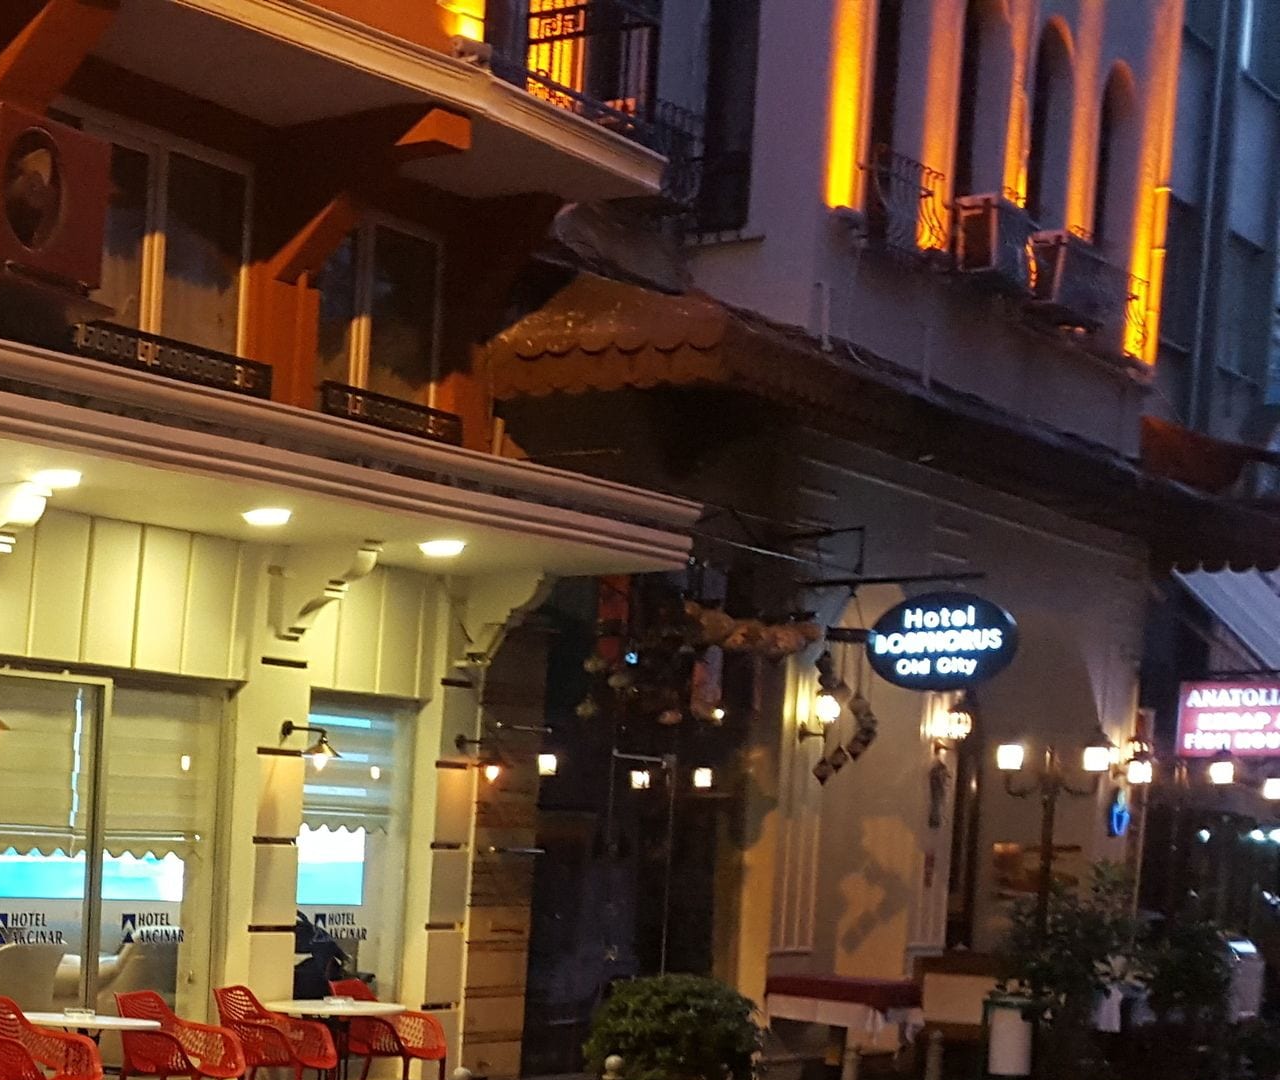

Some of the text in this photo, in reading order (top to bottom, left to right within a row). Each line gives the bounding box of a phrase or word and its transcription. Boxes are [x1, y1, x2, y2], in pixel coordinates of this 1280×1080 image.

[904, 604, 976, 629] Hotel
[896, 657, 931, 675] Old
[11, 913, 47, 927] HOTEL
[138, 913, 171, 926] HOTEL
[328, 913, 356, 926] HOTEL
